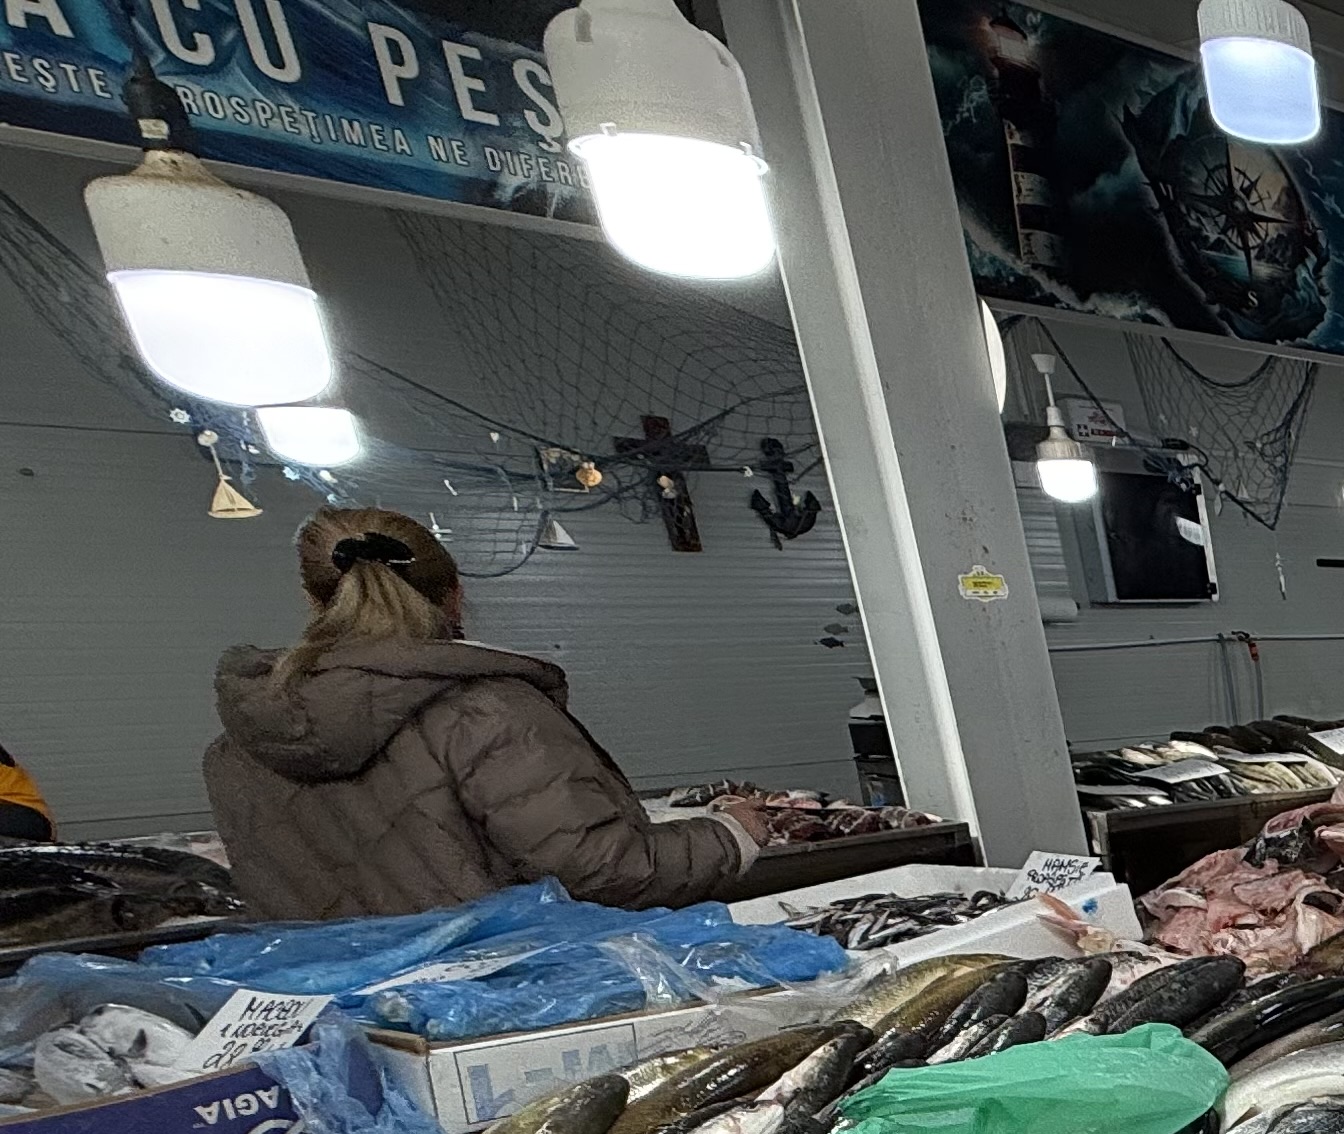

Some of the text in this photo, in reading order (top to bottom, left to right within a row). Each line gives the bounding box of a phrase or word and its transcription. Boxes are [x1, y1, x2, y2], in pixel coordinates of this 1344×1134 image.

[3, 52, 112, 99] EȘTE
[172, 85, 413, 157] ROSPEȚIMEA
[426, 134, 470, 167] NE
[152, 0, 568, 153] CU PEȘ
[193, 1084, 280, 1126] AGIA
